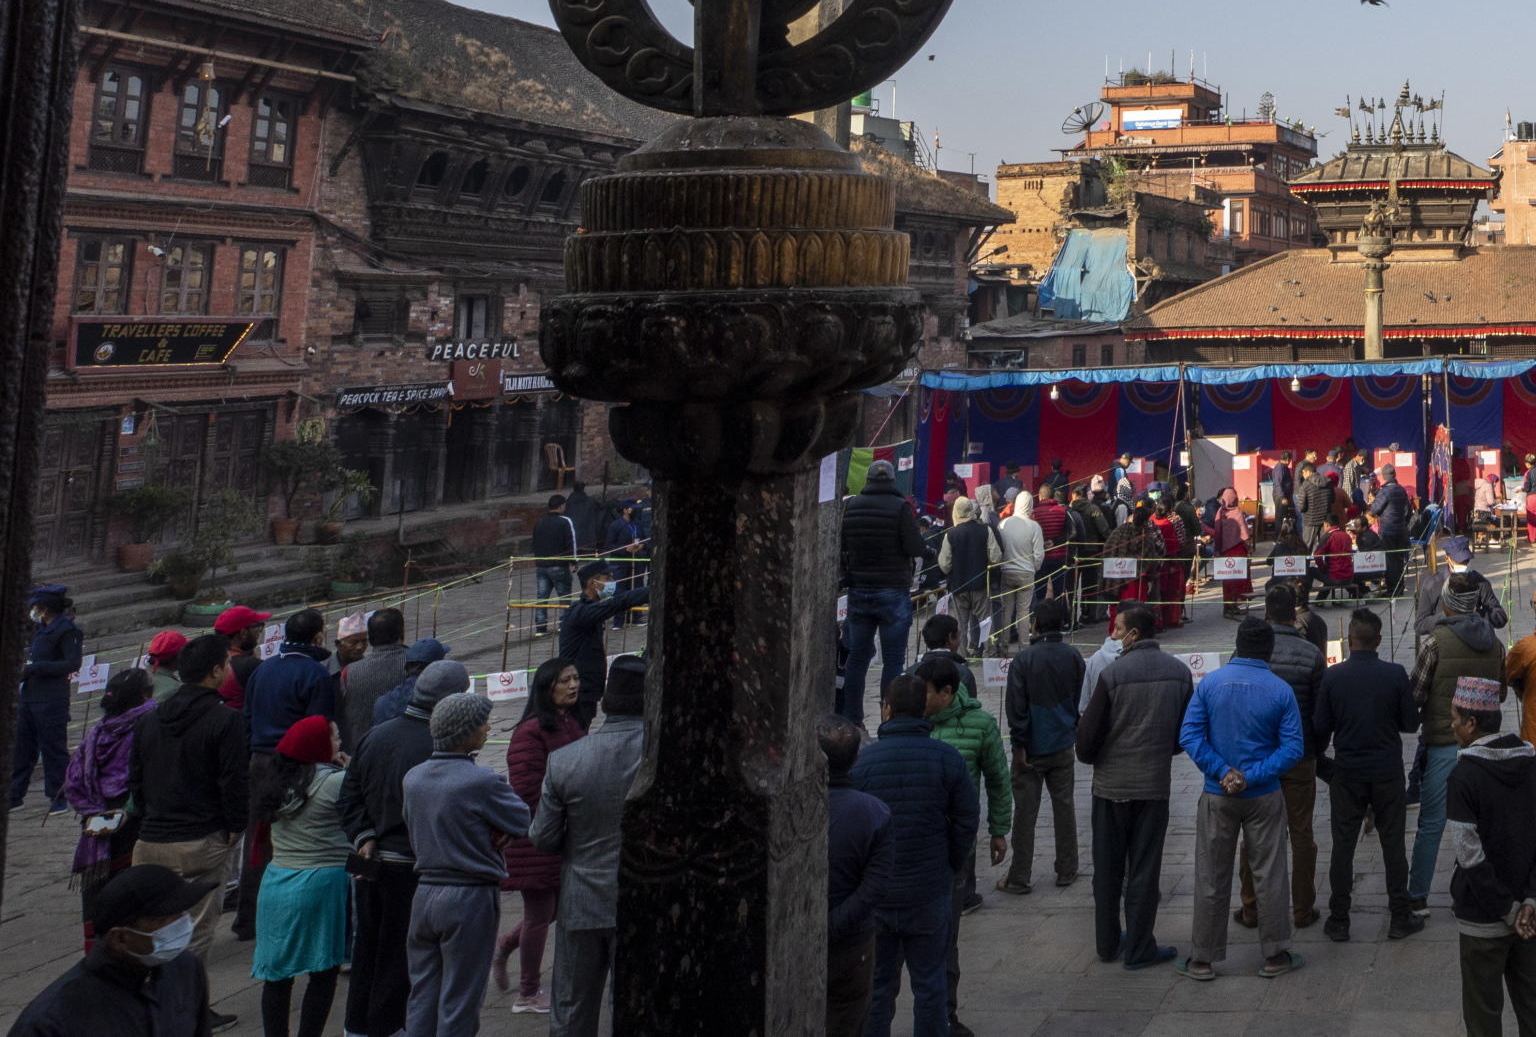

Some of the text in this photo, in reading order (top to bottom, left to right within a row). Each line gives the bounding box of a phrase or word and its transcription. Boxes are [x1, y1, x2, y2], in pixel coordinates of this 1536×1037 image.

[101, 324, 227, 338] TRAVELLERS COFFEE
[158, 338, 168, 348] &
[138, 349, 173, 362] CAFE
[431, 342, 520, 360] PEACEFUL
[340, 392, 381, 405] PEACOCK
[382, 391, 398, 402] TEA
[405, 389, 429, 401] SPICE
